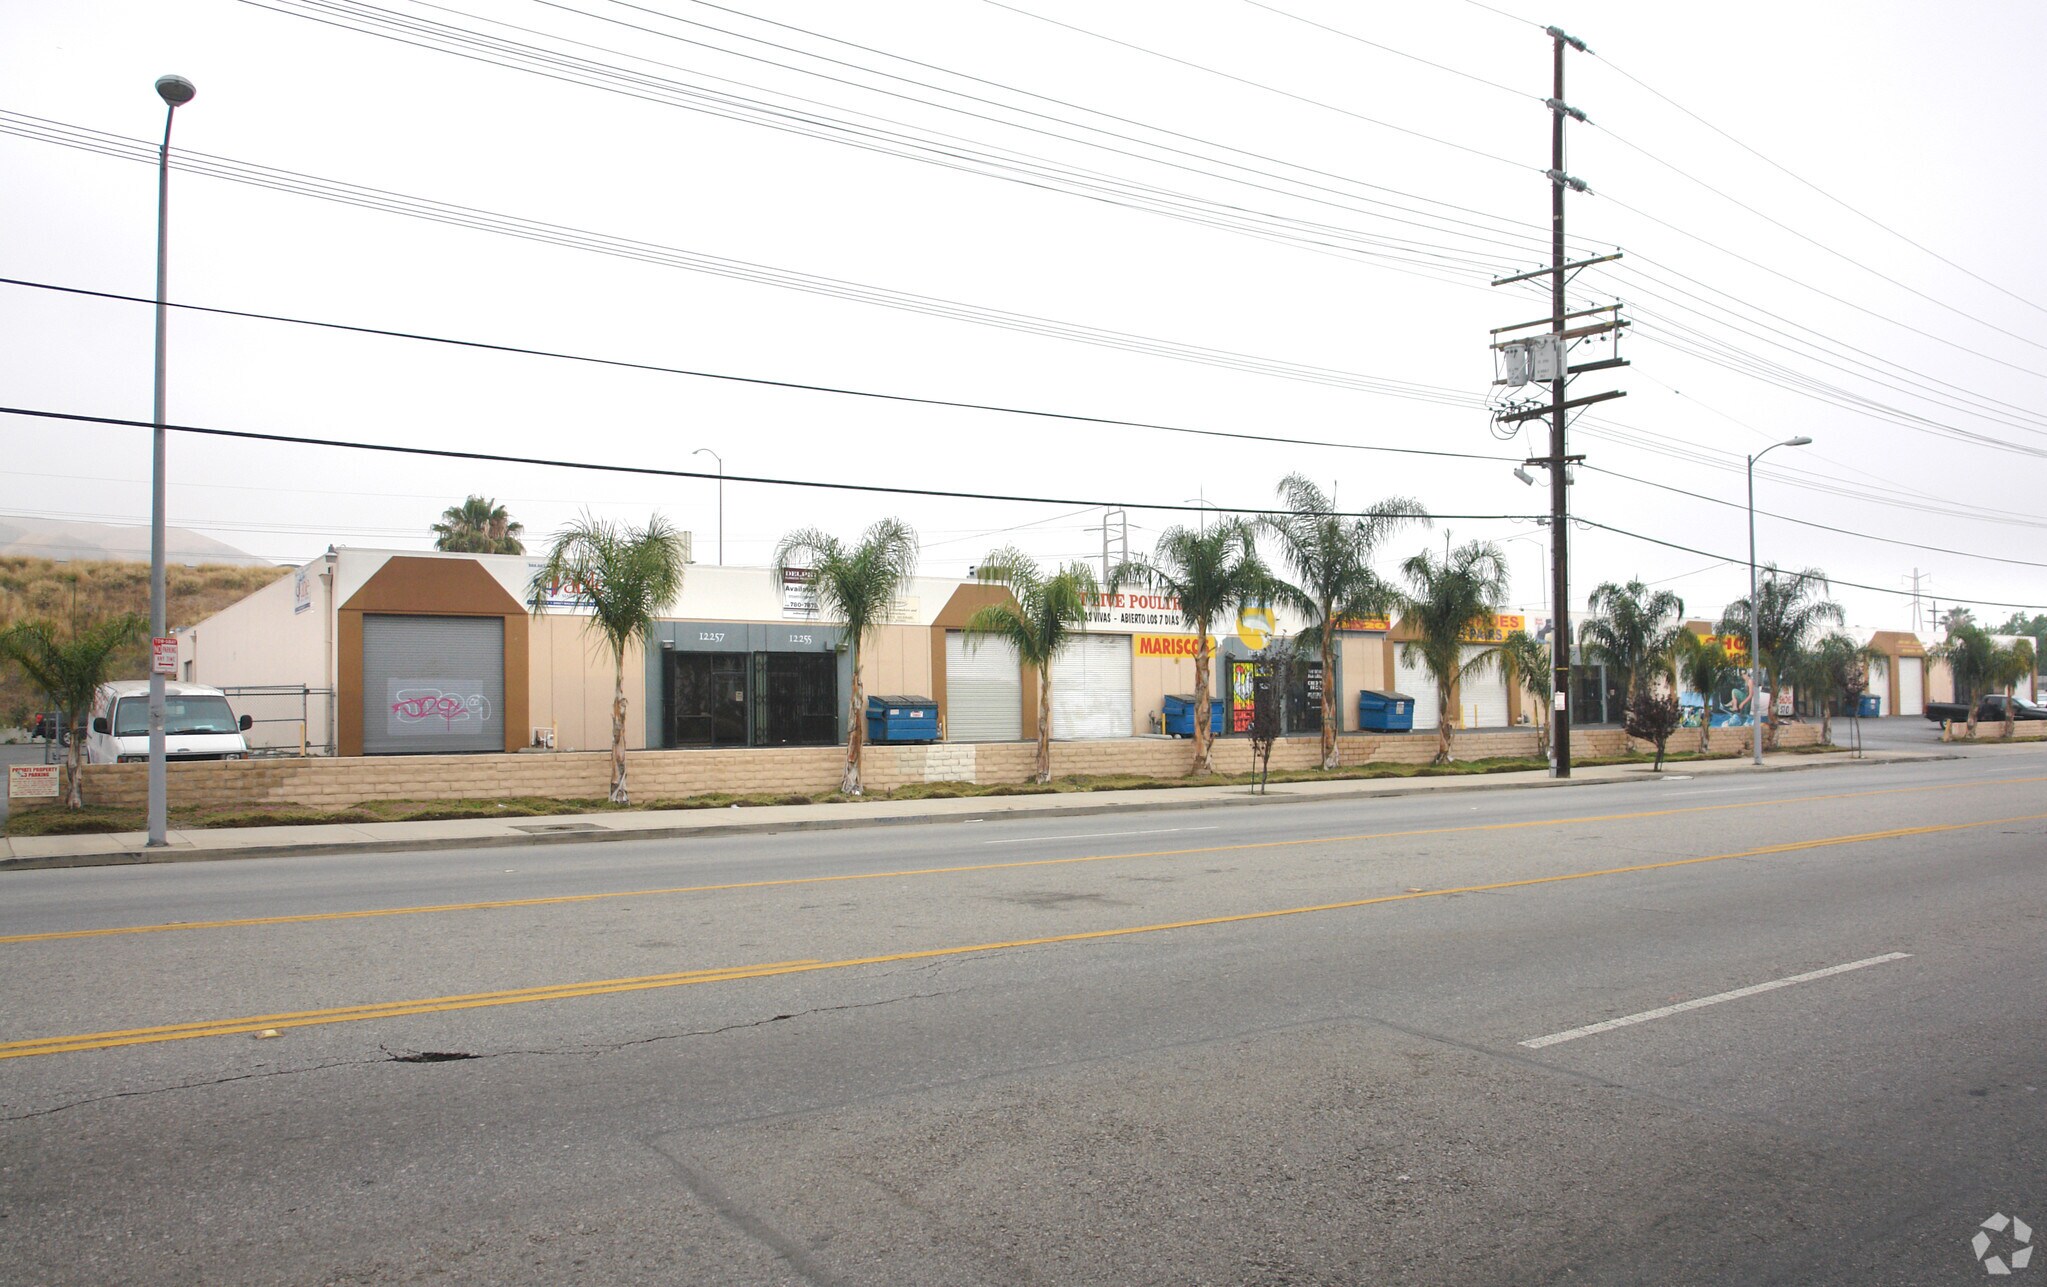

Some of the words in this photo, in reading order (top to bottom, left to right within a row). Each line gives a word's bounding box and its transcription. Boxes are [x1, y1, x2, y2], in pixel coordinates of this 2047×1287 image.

[1129, 594, 1182, 610] POULTR
[1093, 611, 1111, 623] VIVAS
[1121, 613, 1145, 624] ABIERTO
[1147, 614, 1158, 625] LOS
[1159, 614, 1164, 626] 7
[1165, 615, 1180, 626] DIAS
[699, 632, 725, 643] 12257
[789, 634, 812, 644] 12255
